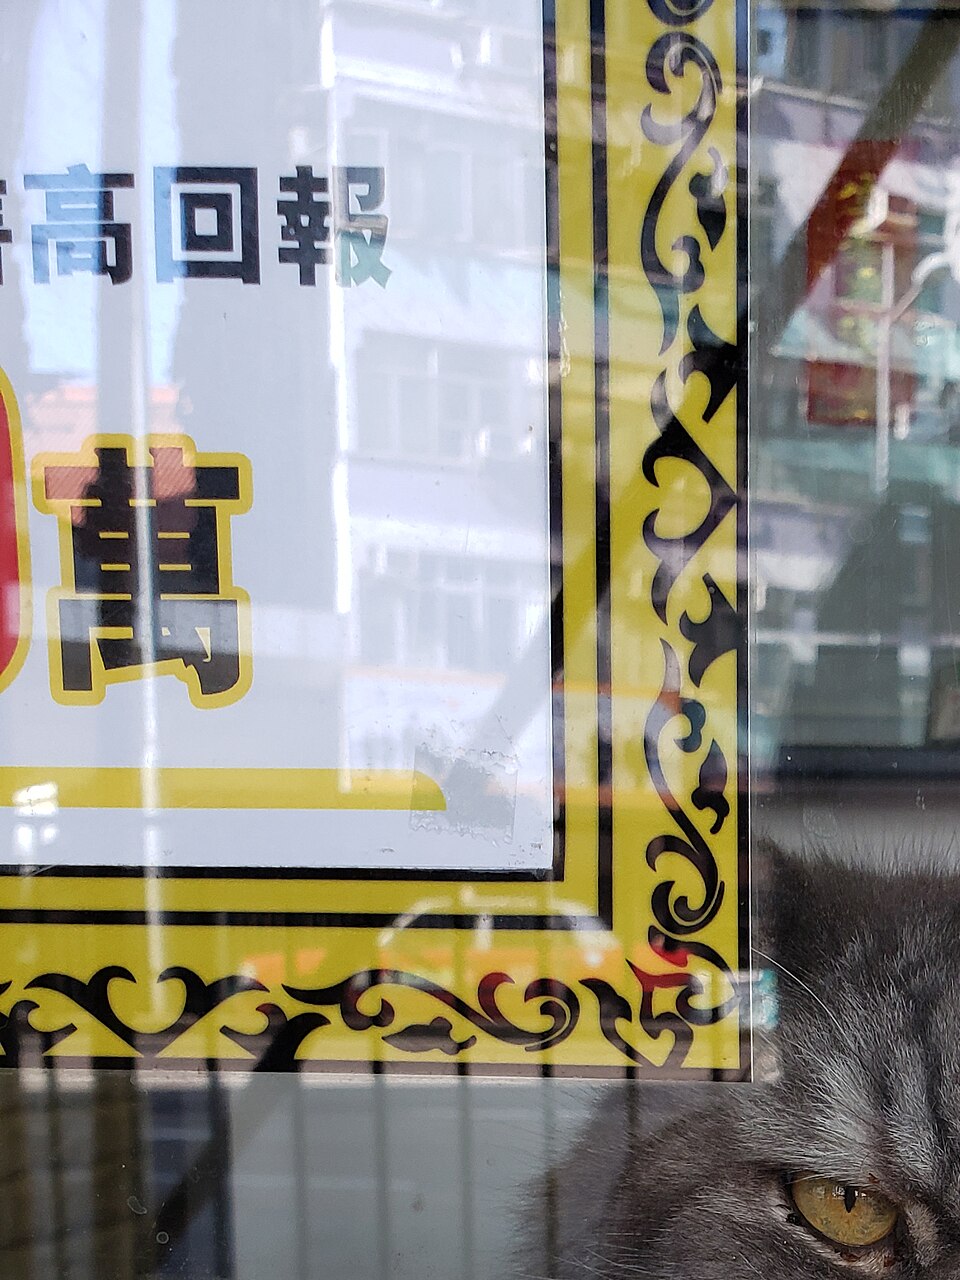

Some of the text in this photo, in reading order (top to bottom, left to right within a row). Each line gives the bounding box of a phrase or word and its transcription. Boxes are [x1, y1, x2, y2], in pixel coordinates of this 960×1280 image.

[0, 163, 393, 288] 高回報
[0, 385, 244, 697] 萬
